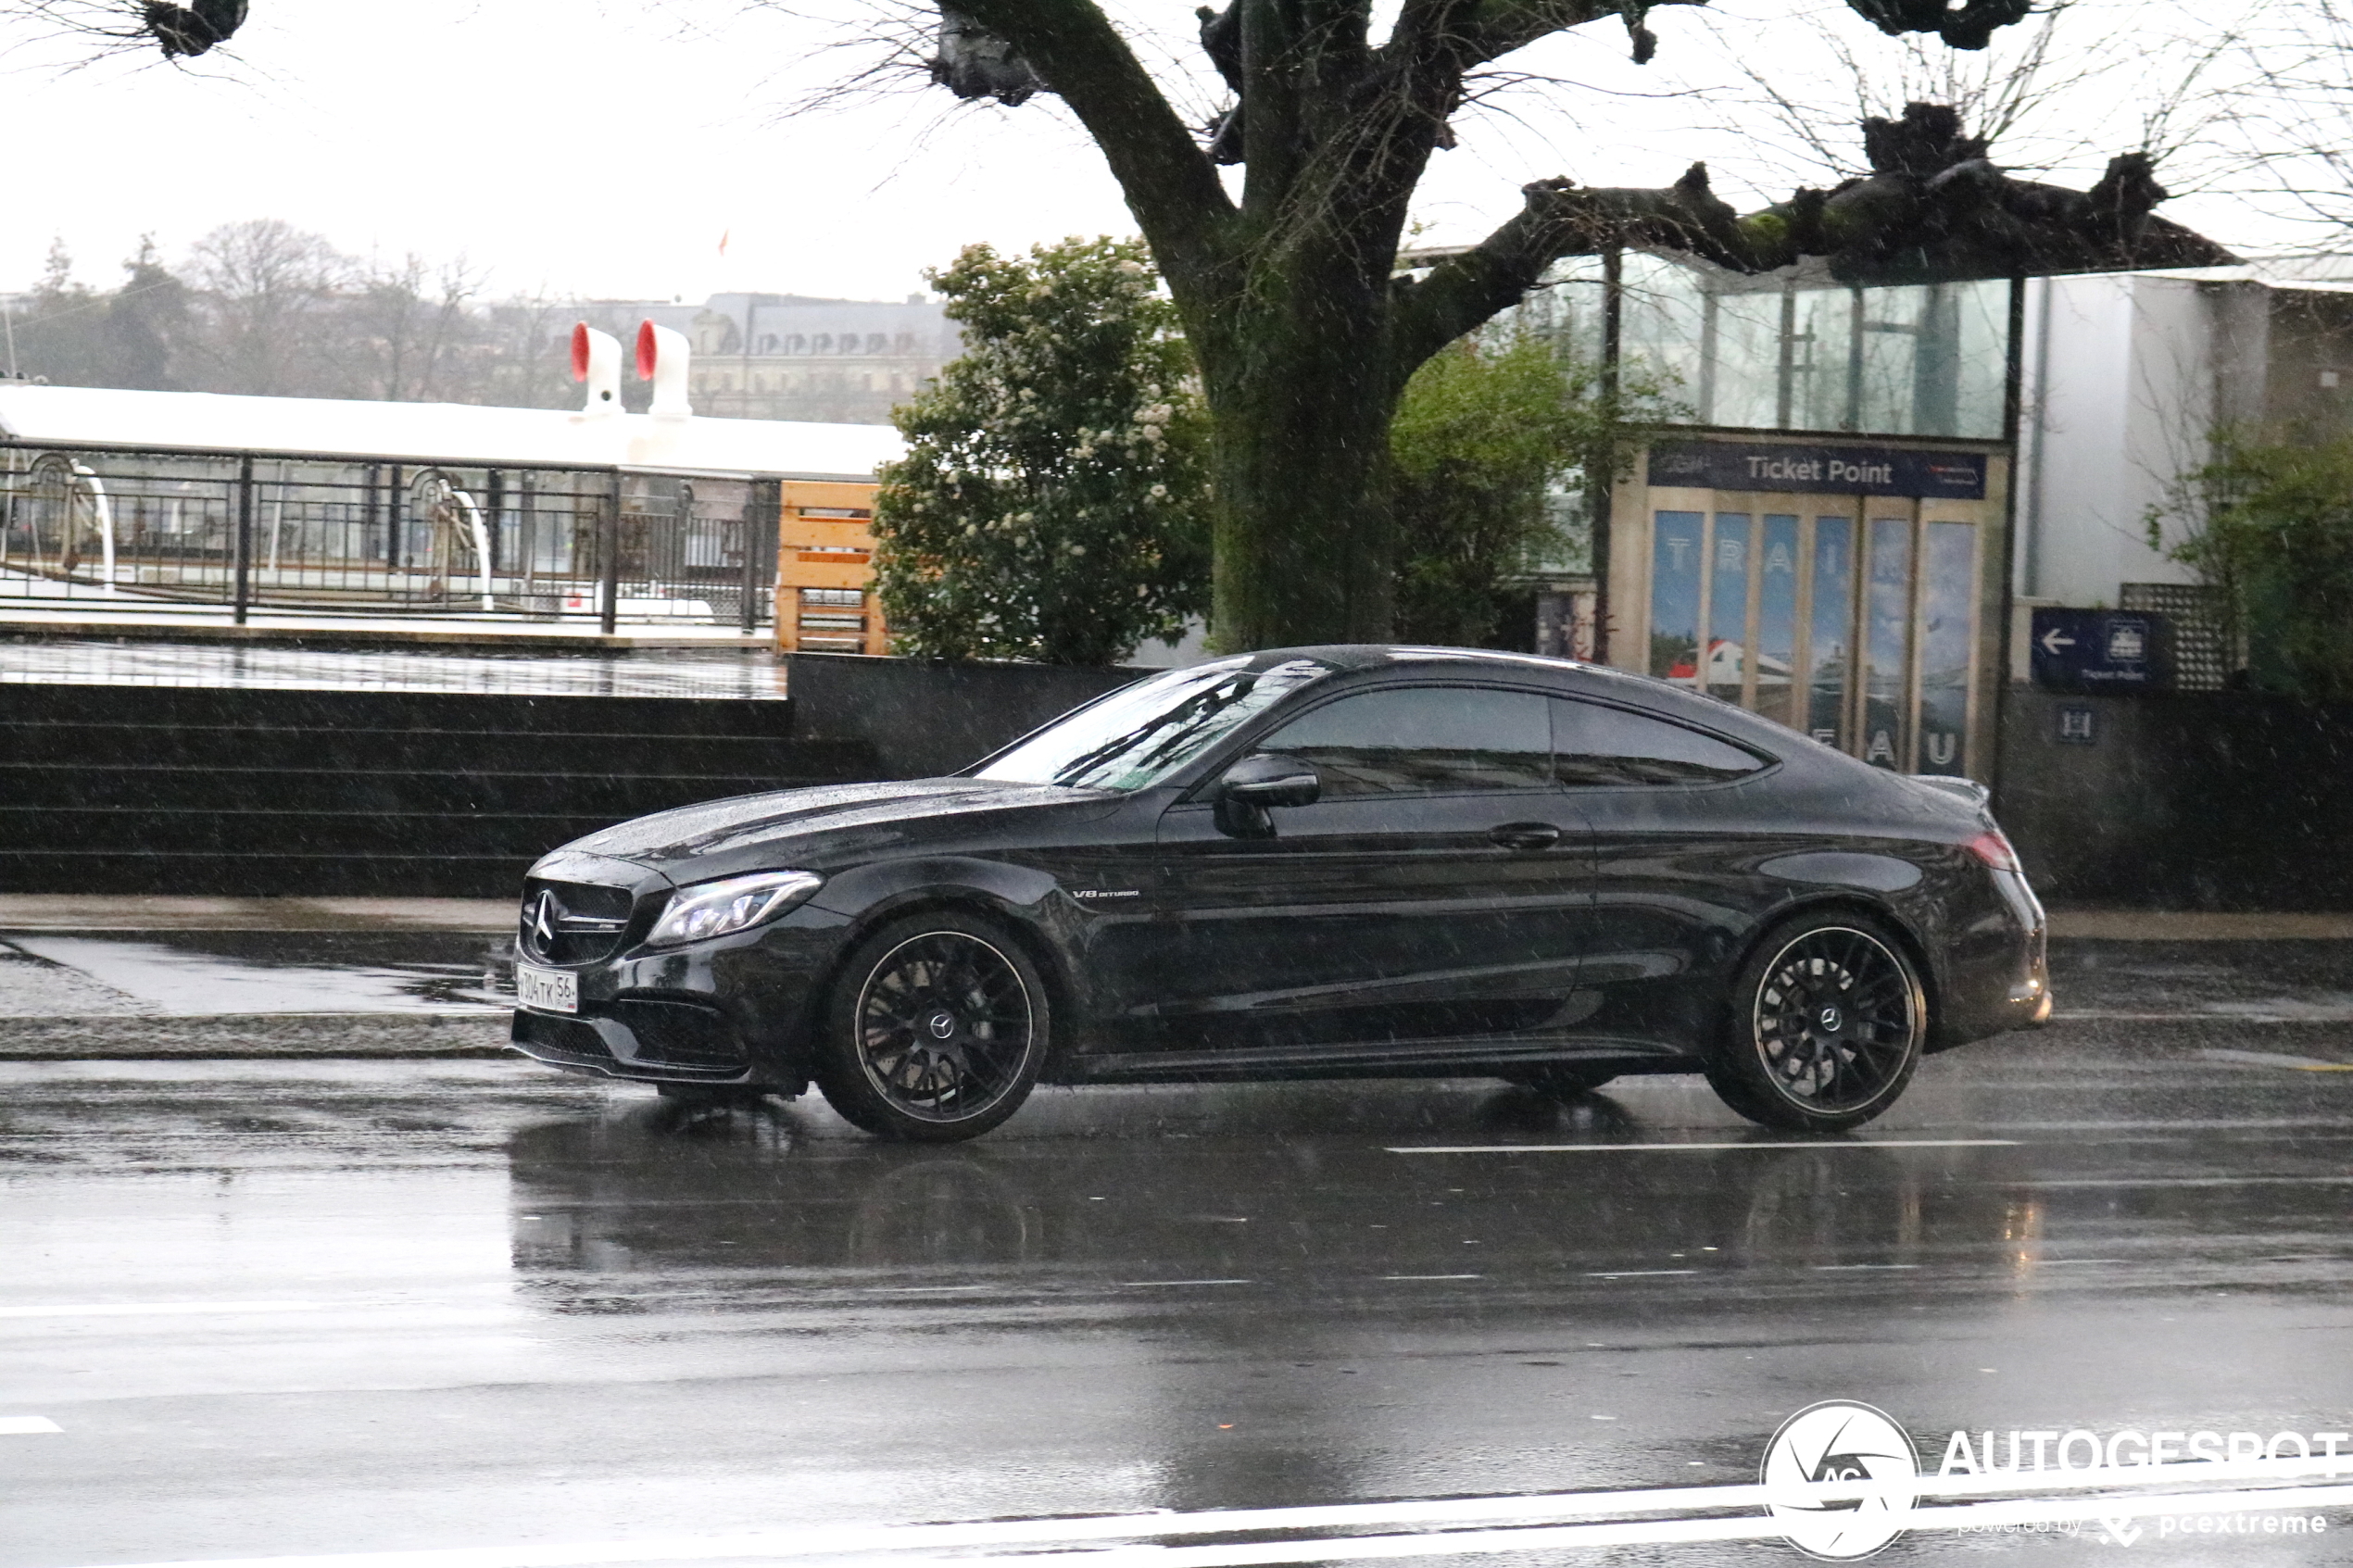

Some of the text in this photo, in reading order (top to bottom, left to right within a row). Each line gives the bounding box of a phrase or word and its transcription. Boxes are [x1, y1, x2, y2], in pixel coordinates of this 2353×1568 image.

[1747, 456, 1893, 484] Ticket Point
[1073, 890, 1097, 898] V8
[558, 976, 571, 997] 56
